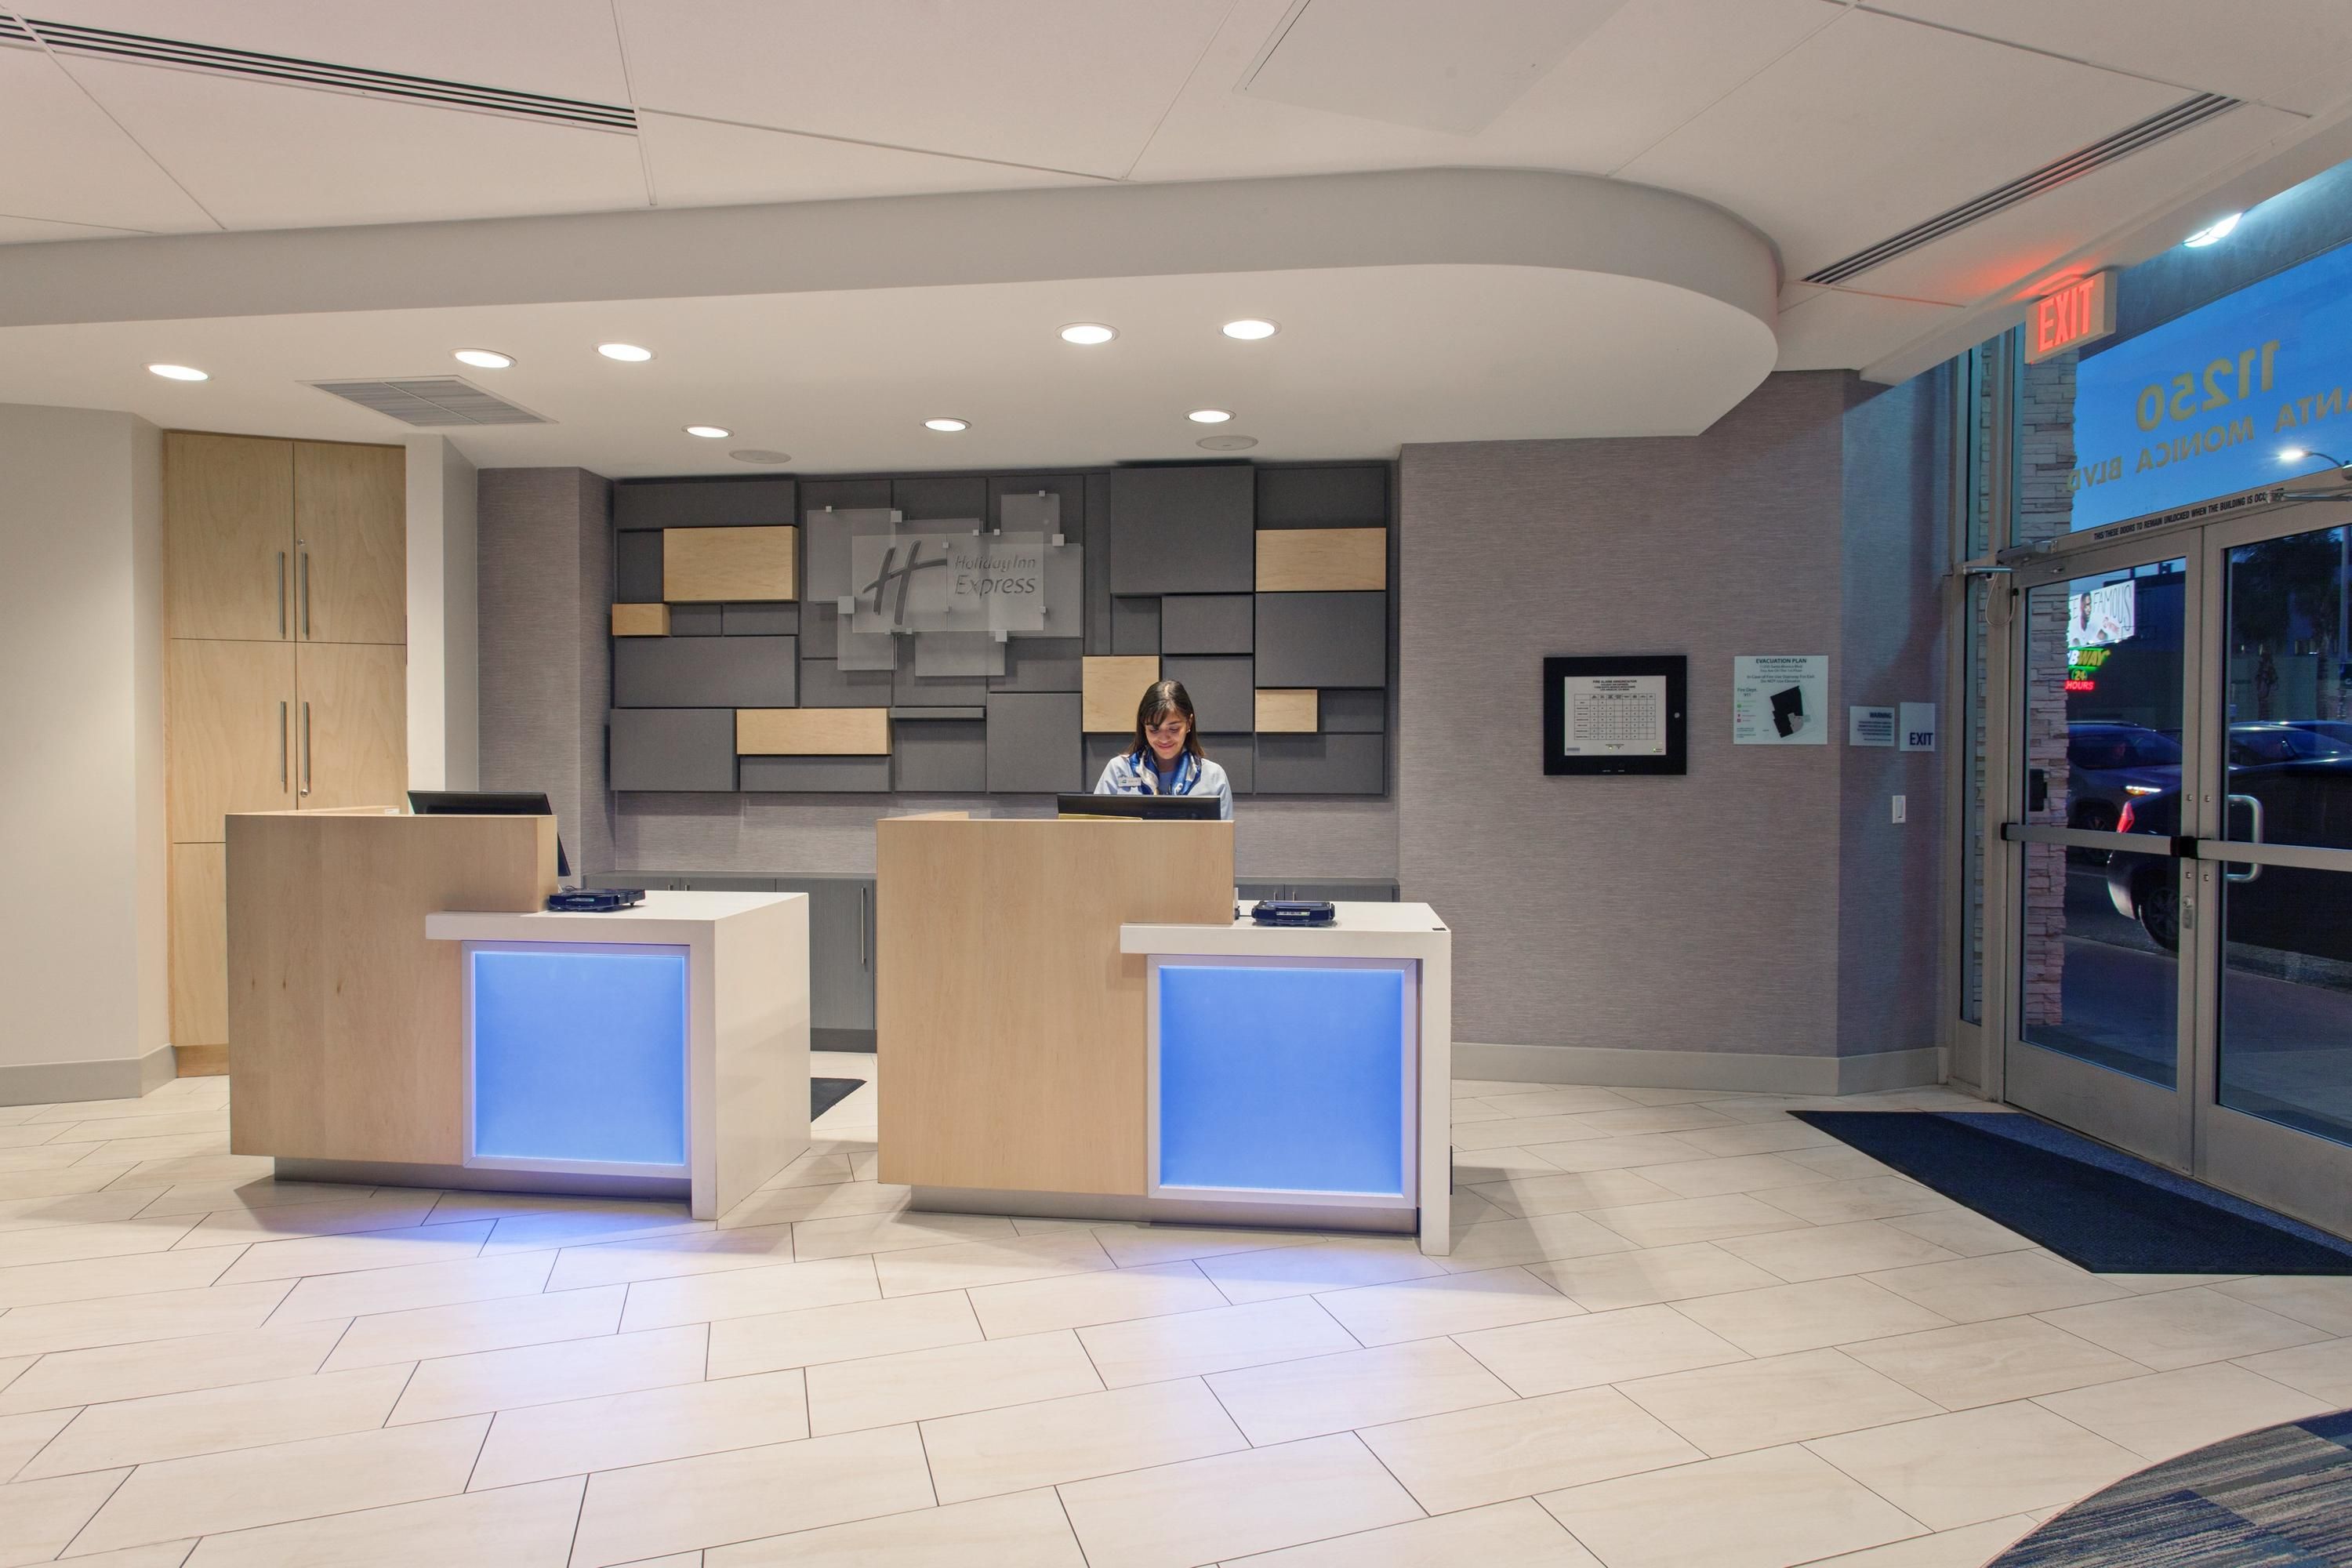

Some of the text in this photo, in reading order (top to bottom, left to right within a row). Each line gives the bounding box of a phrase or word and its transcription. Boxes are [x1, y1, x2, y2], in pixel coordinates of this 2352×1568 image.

[2038, 278, 2094, 352] EXIT
[2119, 524, 2136, 535] DOORS
[2144, 518, 2162, 528] REMAIN
[2164, 510, 2190, 524] UNLOCKED
[2191, 506, 2207, 517] WHEN
[2208, 503, 2219, 514] THE
[2220, 497, 2245, 511] BUILDING
[2247, 495, 2254, 504] IS
[954, 574, 1036, 600] Express
[2093, 585, 2132, 632] FAMOUS
[2067, 650, 2109, 666] BWAY
[2065, 681, 2095, 690] HOURS
[2074, 670, 2087, 681] 24
[1909, 732, 1933, 746] EXIT
